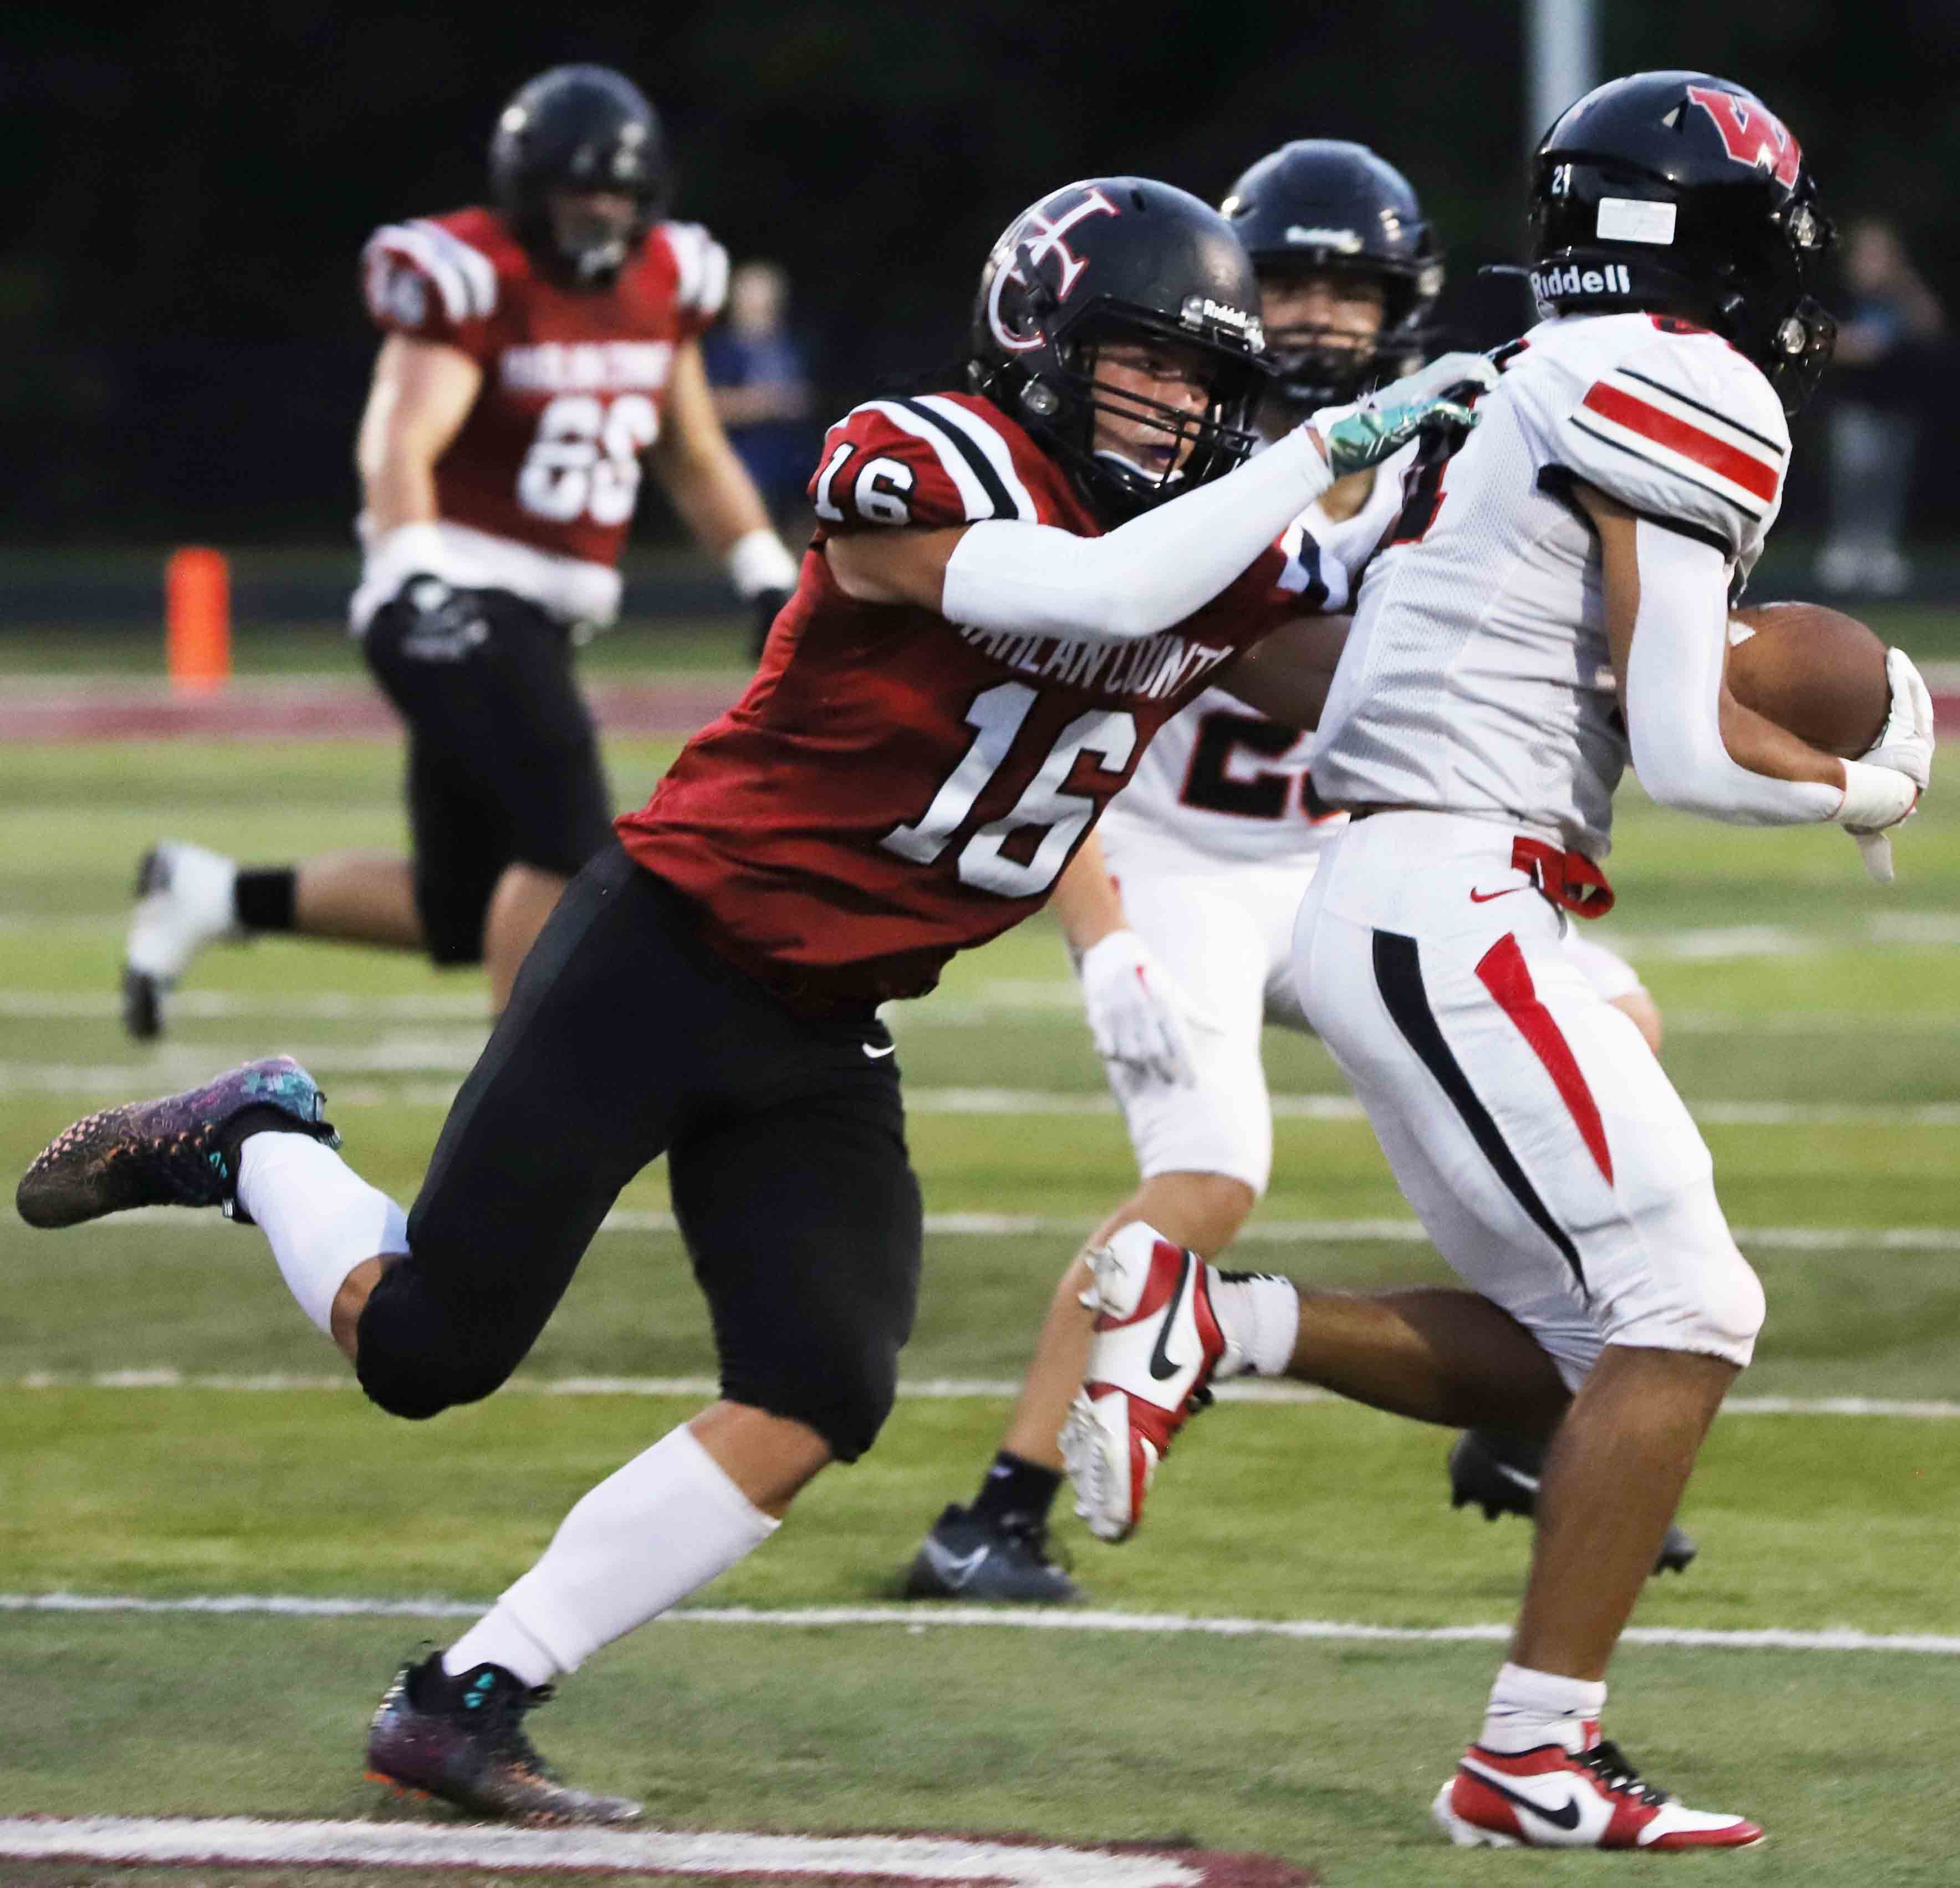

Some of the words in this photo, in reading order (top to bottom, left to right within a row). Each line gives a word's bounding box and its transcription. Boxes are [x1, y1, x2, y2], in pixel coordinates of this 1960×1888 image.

[1551, 163, 1573, 194] 21
[1687, 85, 1801, 190] W
[1530, 264, 1631, 300] Riddell
[815, 442, 917, 527] 16
[879, 680, 1138, 898] 16
[1178, 707, 1330, 825] 2
